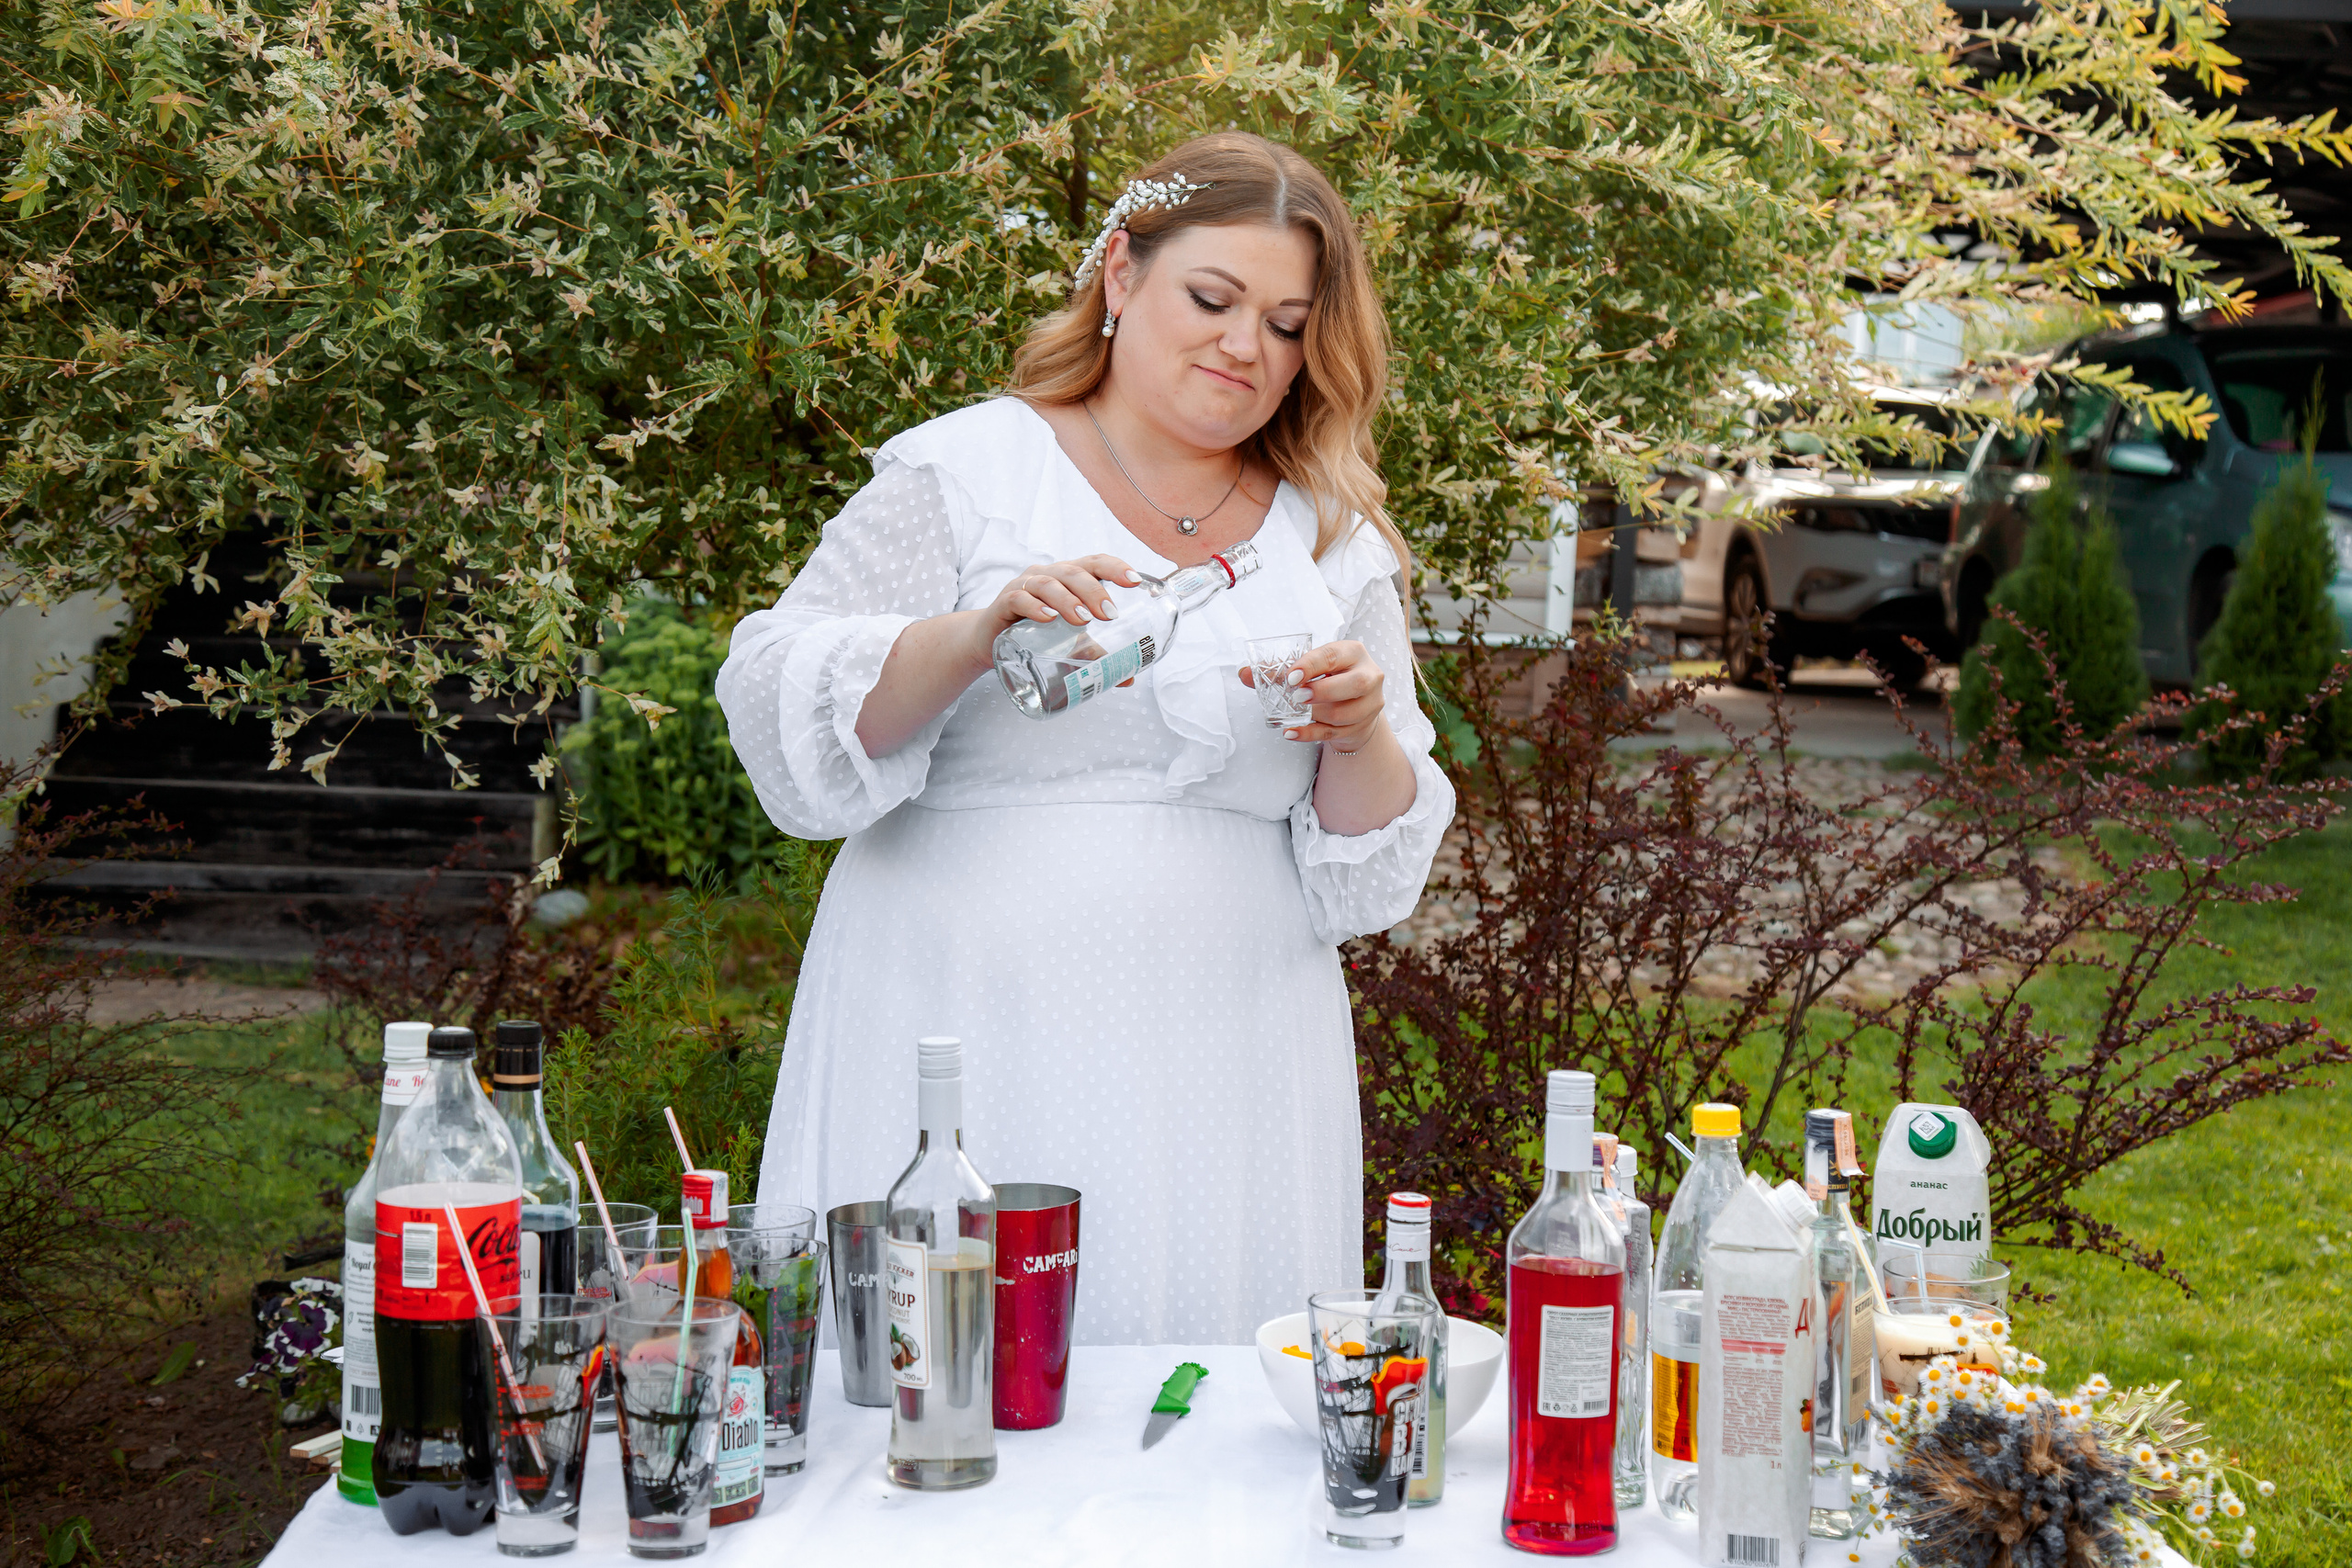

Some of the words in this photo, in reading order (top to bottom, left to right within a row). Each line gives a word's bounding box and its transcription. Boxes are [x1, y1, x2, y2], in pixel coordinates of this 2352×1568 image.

[1910, 1180, 1949, 1190] ананас
[1876, 1207, 1982, 1247] Добрый
[888, 1290, 916, 1308] YRUP
[722, 1417, 759, 1451] Diablo
